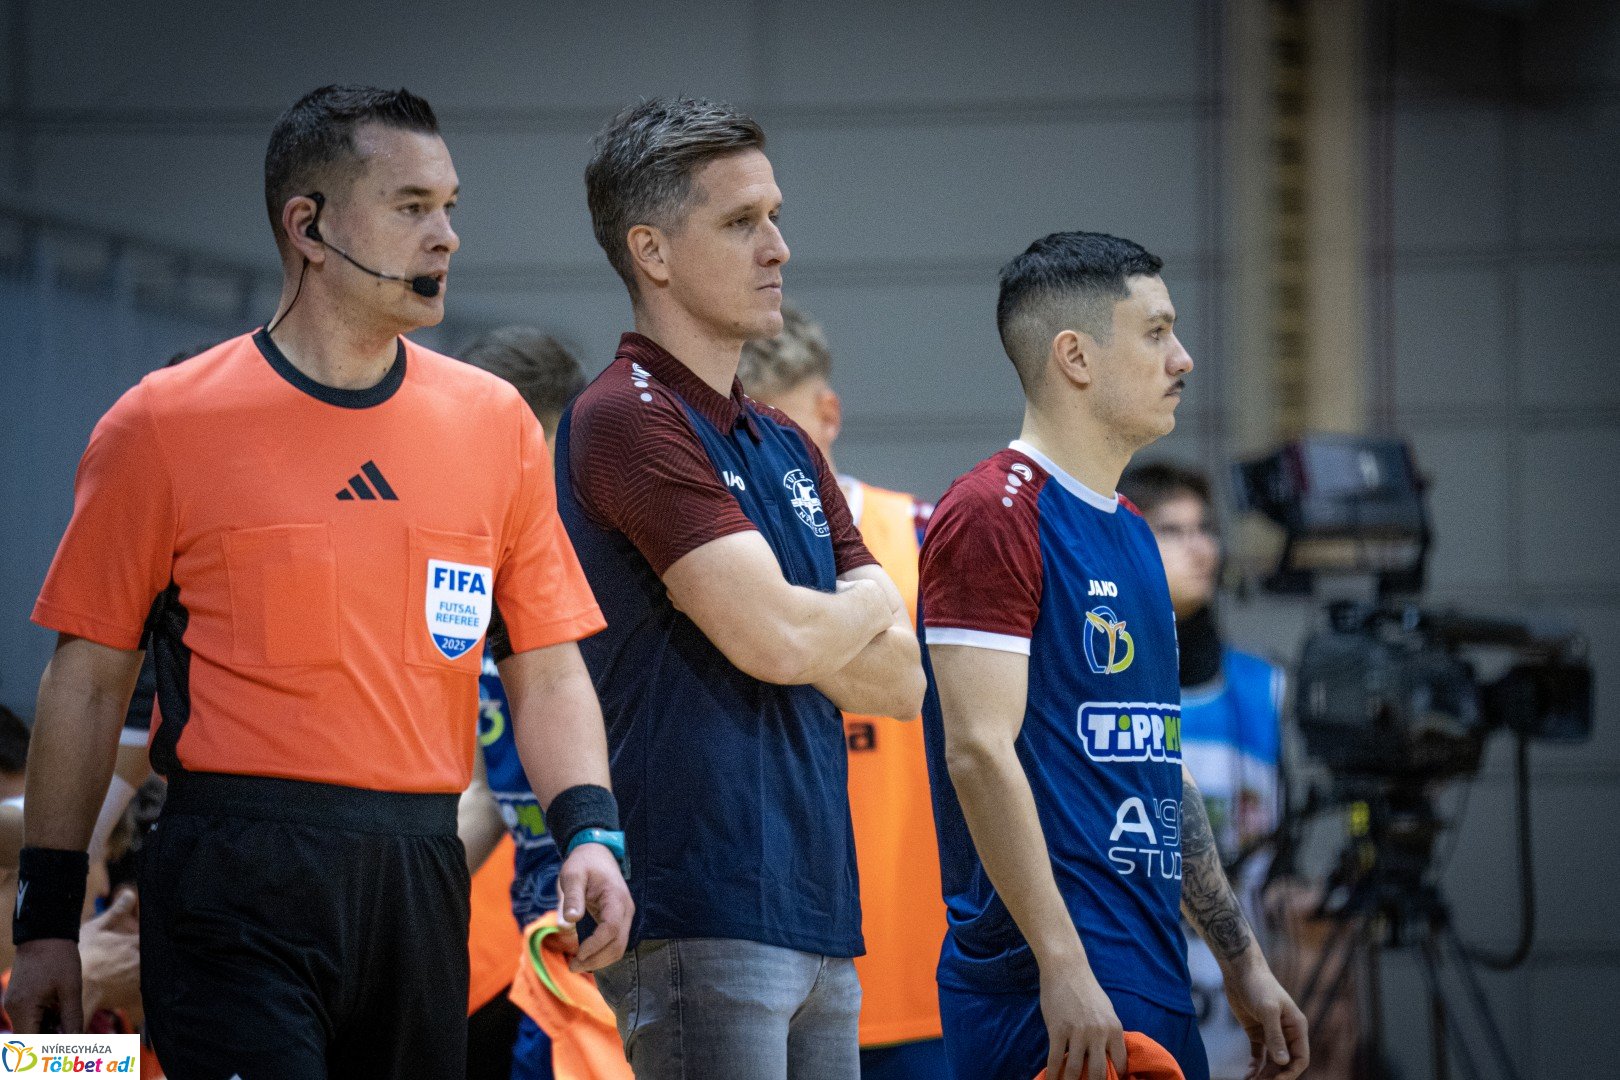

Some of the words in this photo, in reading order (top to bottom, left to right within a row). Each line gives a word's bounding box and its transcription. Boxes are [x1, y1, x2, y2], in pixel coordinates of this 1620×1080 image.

[433, 567, 486, 595] FIFA
[1088, 579, 1118, 598] JAKO
[439, 601, 478, 615] FUTSAL
[435, 612, 480, 627] REFEREE
[441, 637, 467, 651] 2025
